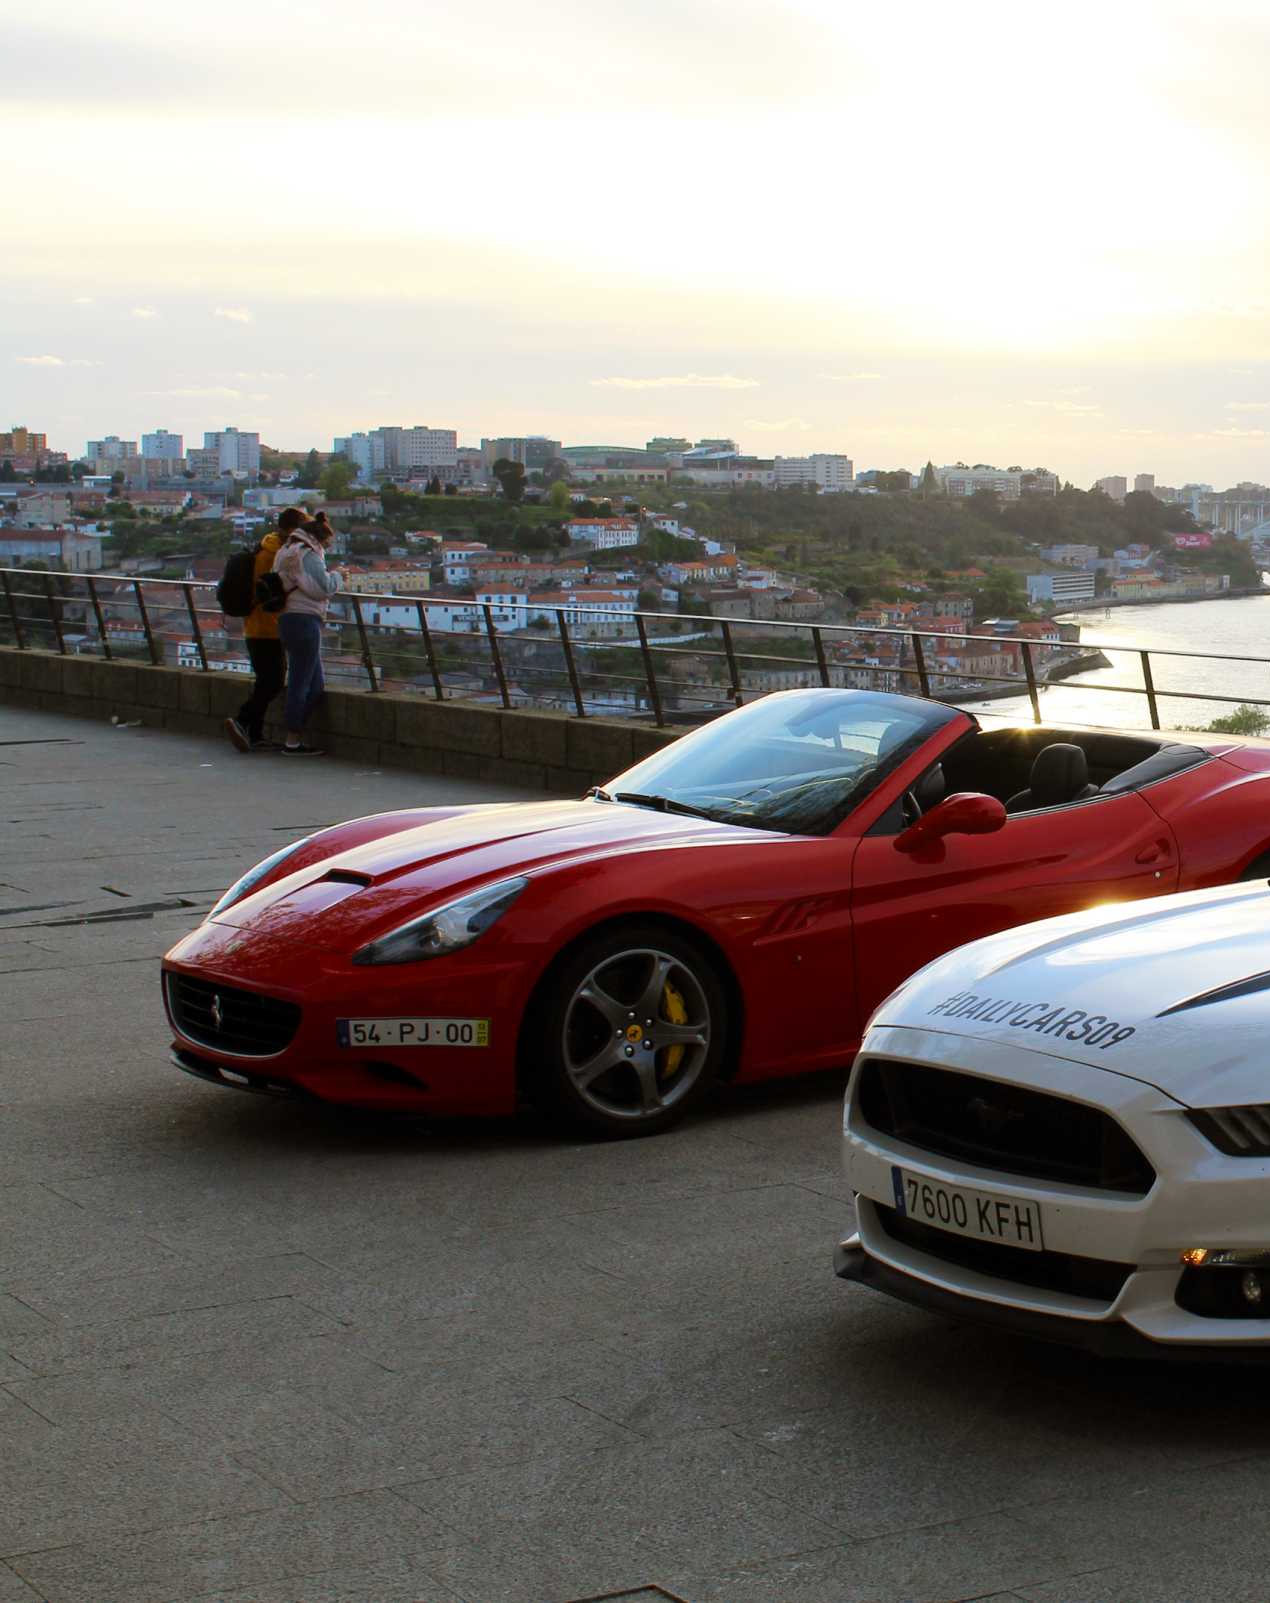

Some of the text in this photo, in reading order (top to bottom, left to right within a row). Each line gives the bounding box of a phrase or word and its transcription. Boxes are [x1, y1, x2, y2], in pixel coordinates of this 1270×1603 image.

[478, 1023, 486, 1031] 13
[927, 991, 1136, 1049] #DAILYCARS09
[907, 1178, 1034, 1243] 7600 KFH
